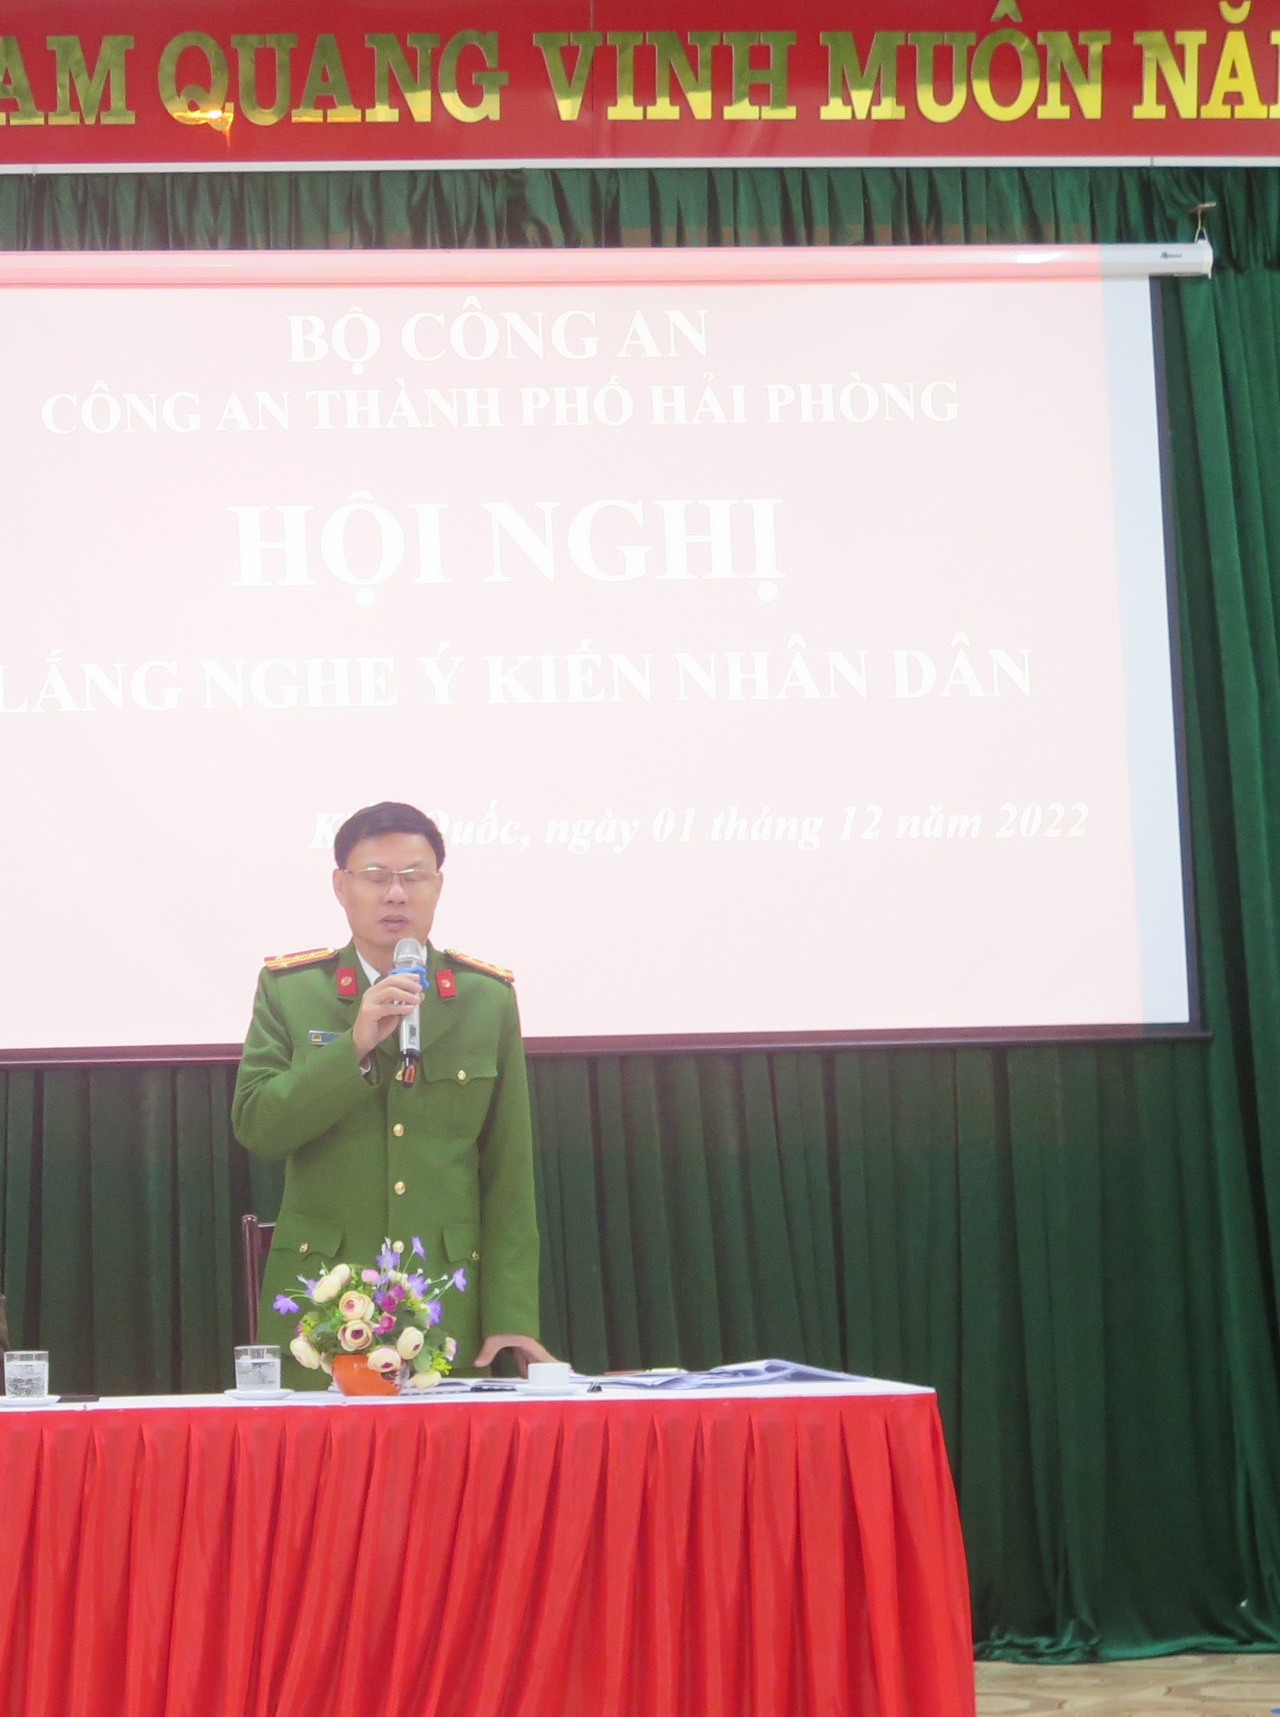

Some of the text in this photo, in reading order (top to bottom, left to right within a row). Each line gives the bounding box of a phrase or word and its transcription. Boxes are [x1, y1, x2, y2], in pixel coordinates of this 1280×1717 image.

[158, 30, 509, 132] QUANG
[532, 29, 798, 121] VINH
[819, 0, 1113, 123] MUÔN
[1132, 0, 1280, 120] NĂ
[286, 295, 710, 376] BỘ CÔNG AN
[40, 370, 960, 435] CÔNG AN THÀNH PHỐ HẢI PHÒNG
[227, 489, 787, 609] HỘI NGHỊ
[199, 656, 399, 710] NGHE
[416, 640, 465, 707] Ý
[483, 638, 655, 704] KIẾN
[673, 632, 871, 701] NHÂN
[891, 631, 1032, 699] DÂN
[544, 807, 641, 855] ngày
[651, 806, 697, 843] 01
[710, 804, 825, 852] tháng
[838, 804, 885, 841] 12
[895, 803, 982, 840] năm
[994, 802, 1090, 839] 2022
